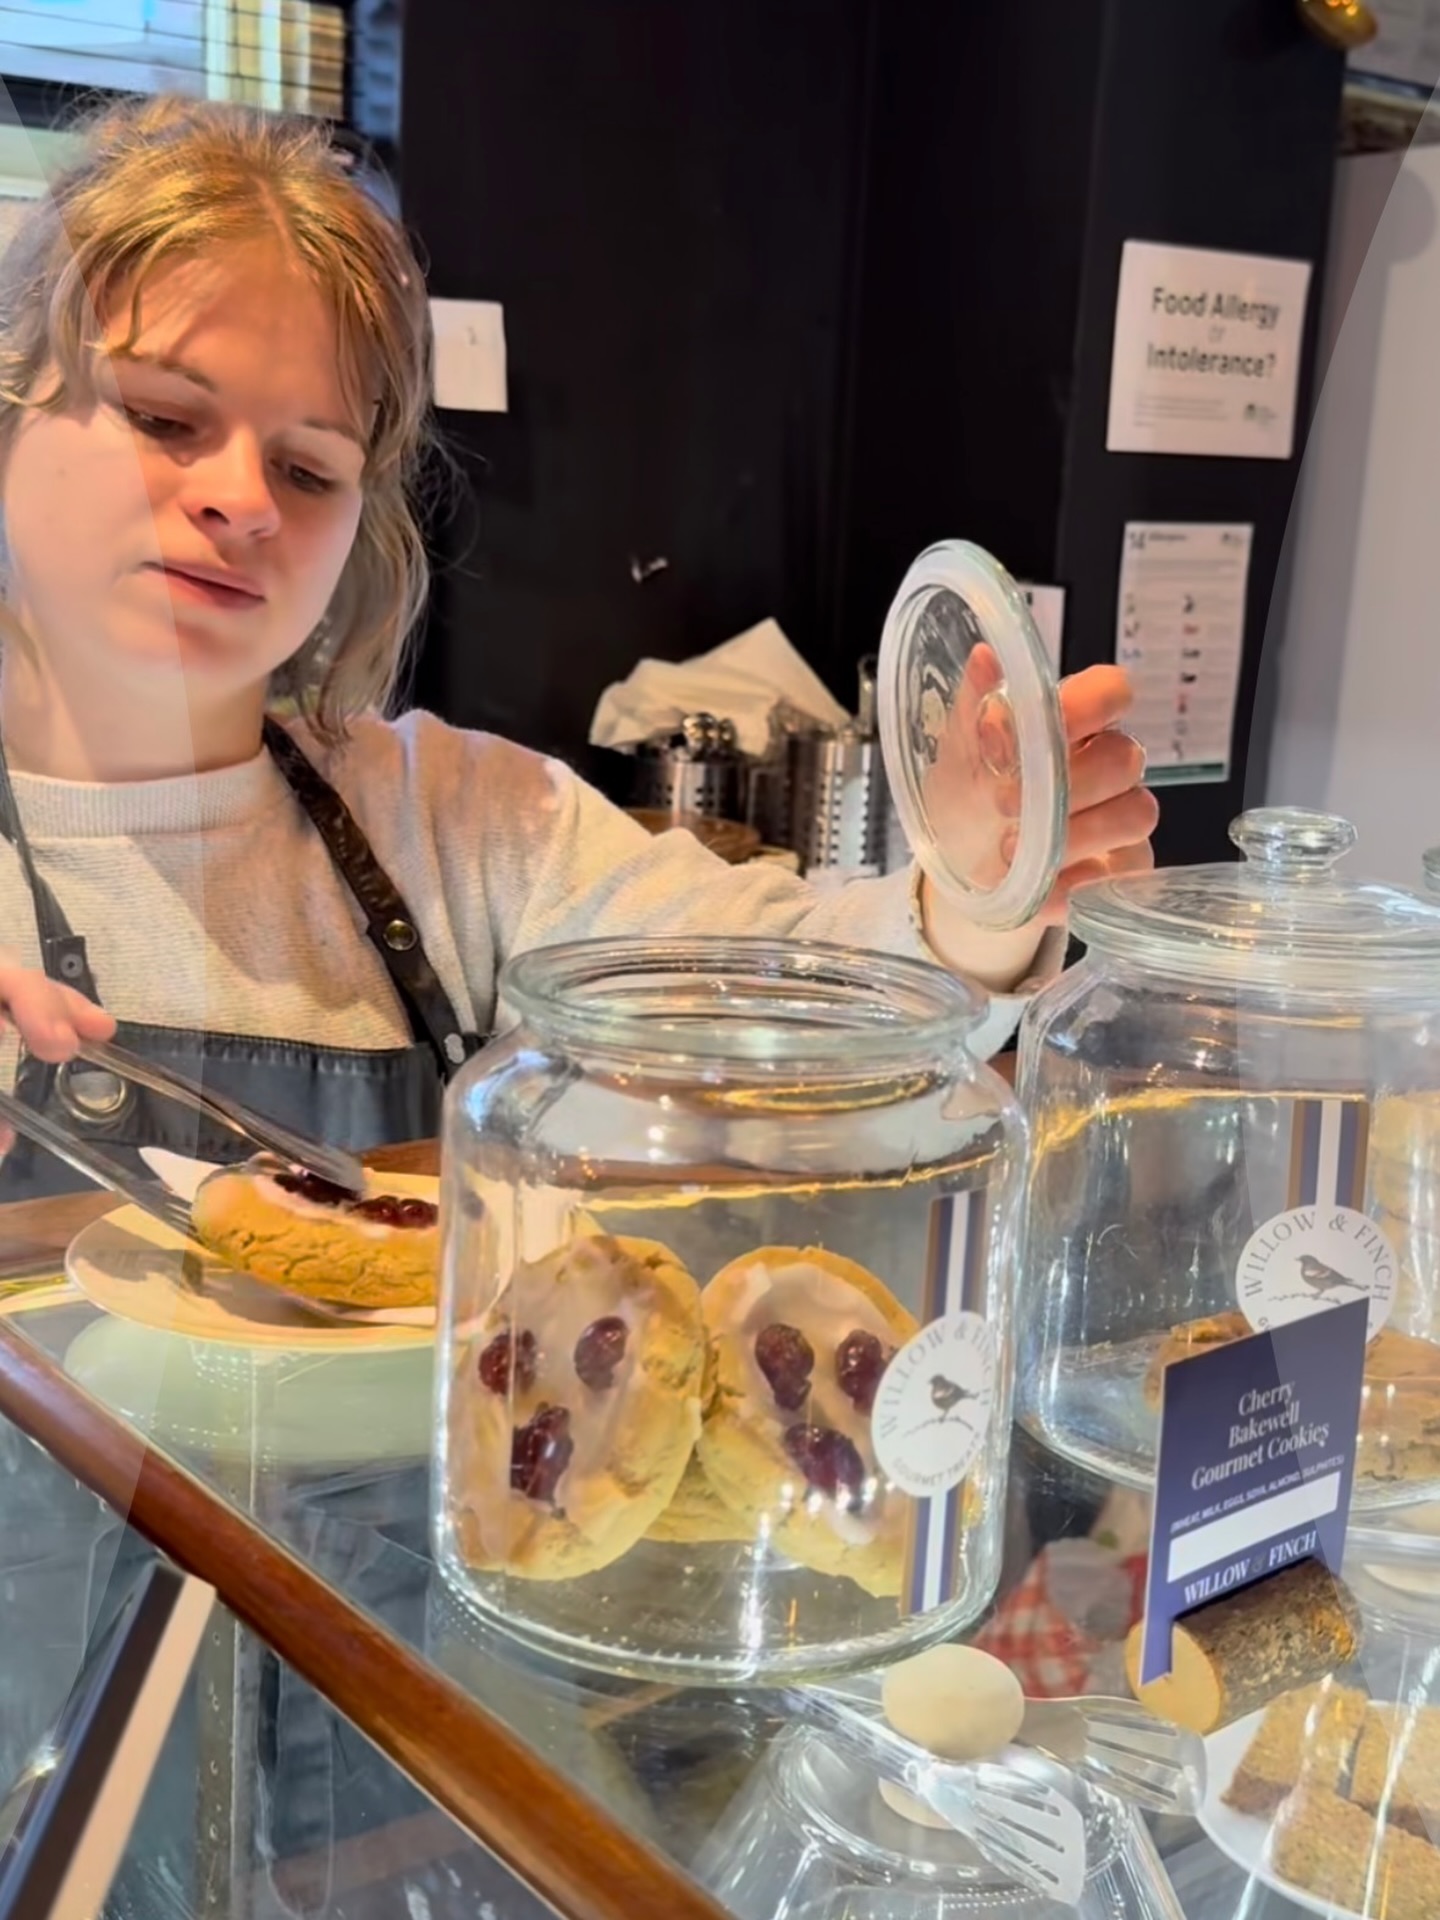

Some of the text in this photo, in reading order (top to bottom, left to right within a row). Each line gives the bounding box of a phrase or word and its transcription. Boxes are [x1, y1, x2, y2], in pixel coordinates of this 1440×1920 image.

[1153, 286, 1281, 331] Food Allergy
[1147, 343, 1277, 378] Intolerance?
[1243, 1211, 1392, 1301] WILLOW & FINCH
[880, 1321, 946, 1439] WILLOW
[1238, 1381, 1295, 1417] Cherry
[1228, 1400, 1300, 1449] Bakewell
[1191, 1421, 1330, 1491] Gourmet Cookies
[1184, 1557, 1251, 1605] WILLOW
[1268, 1529, 1317, 1567] FINCH
